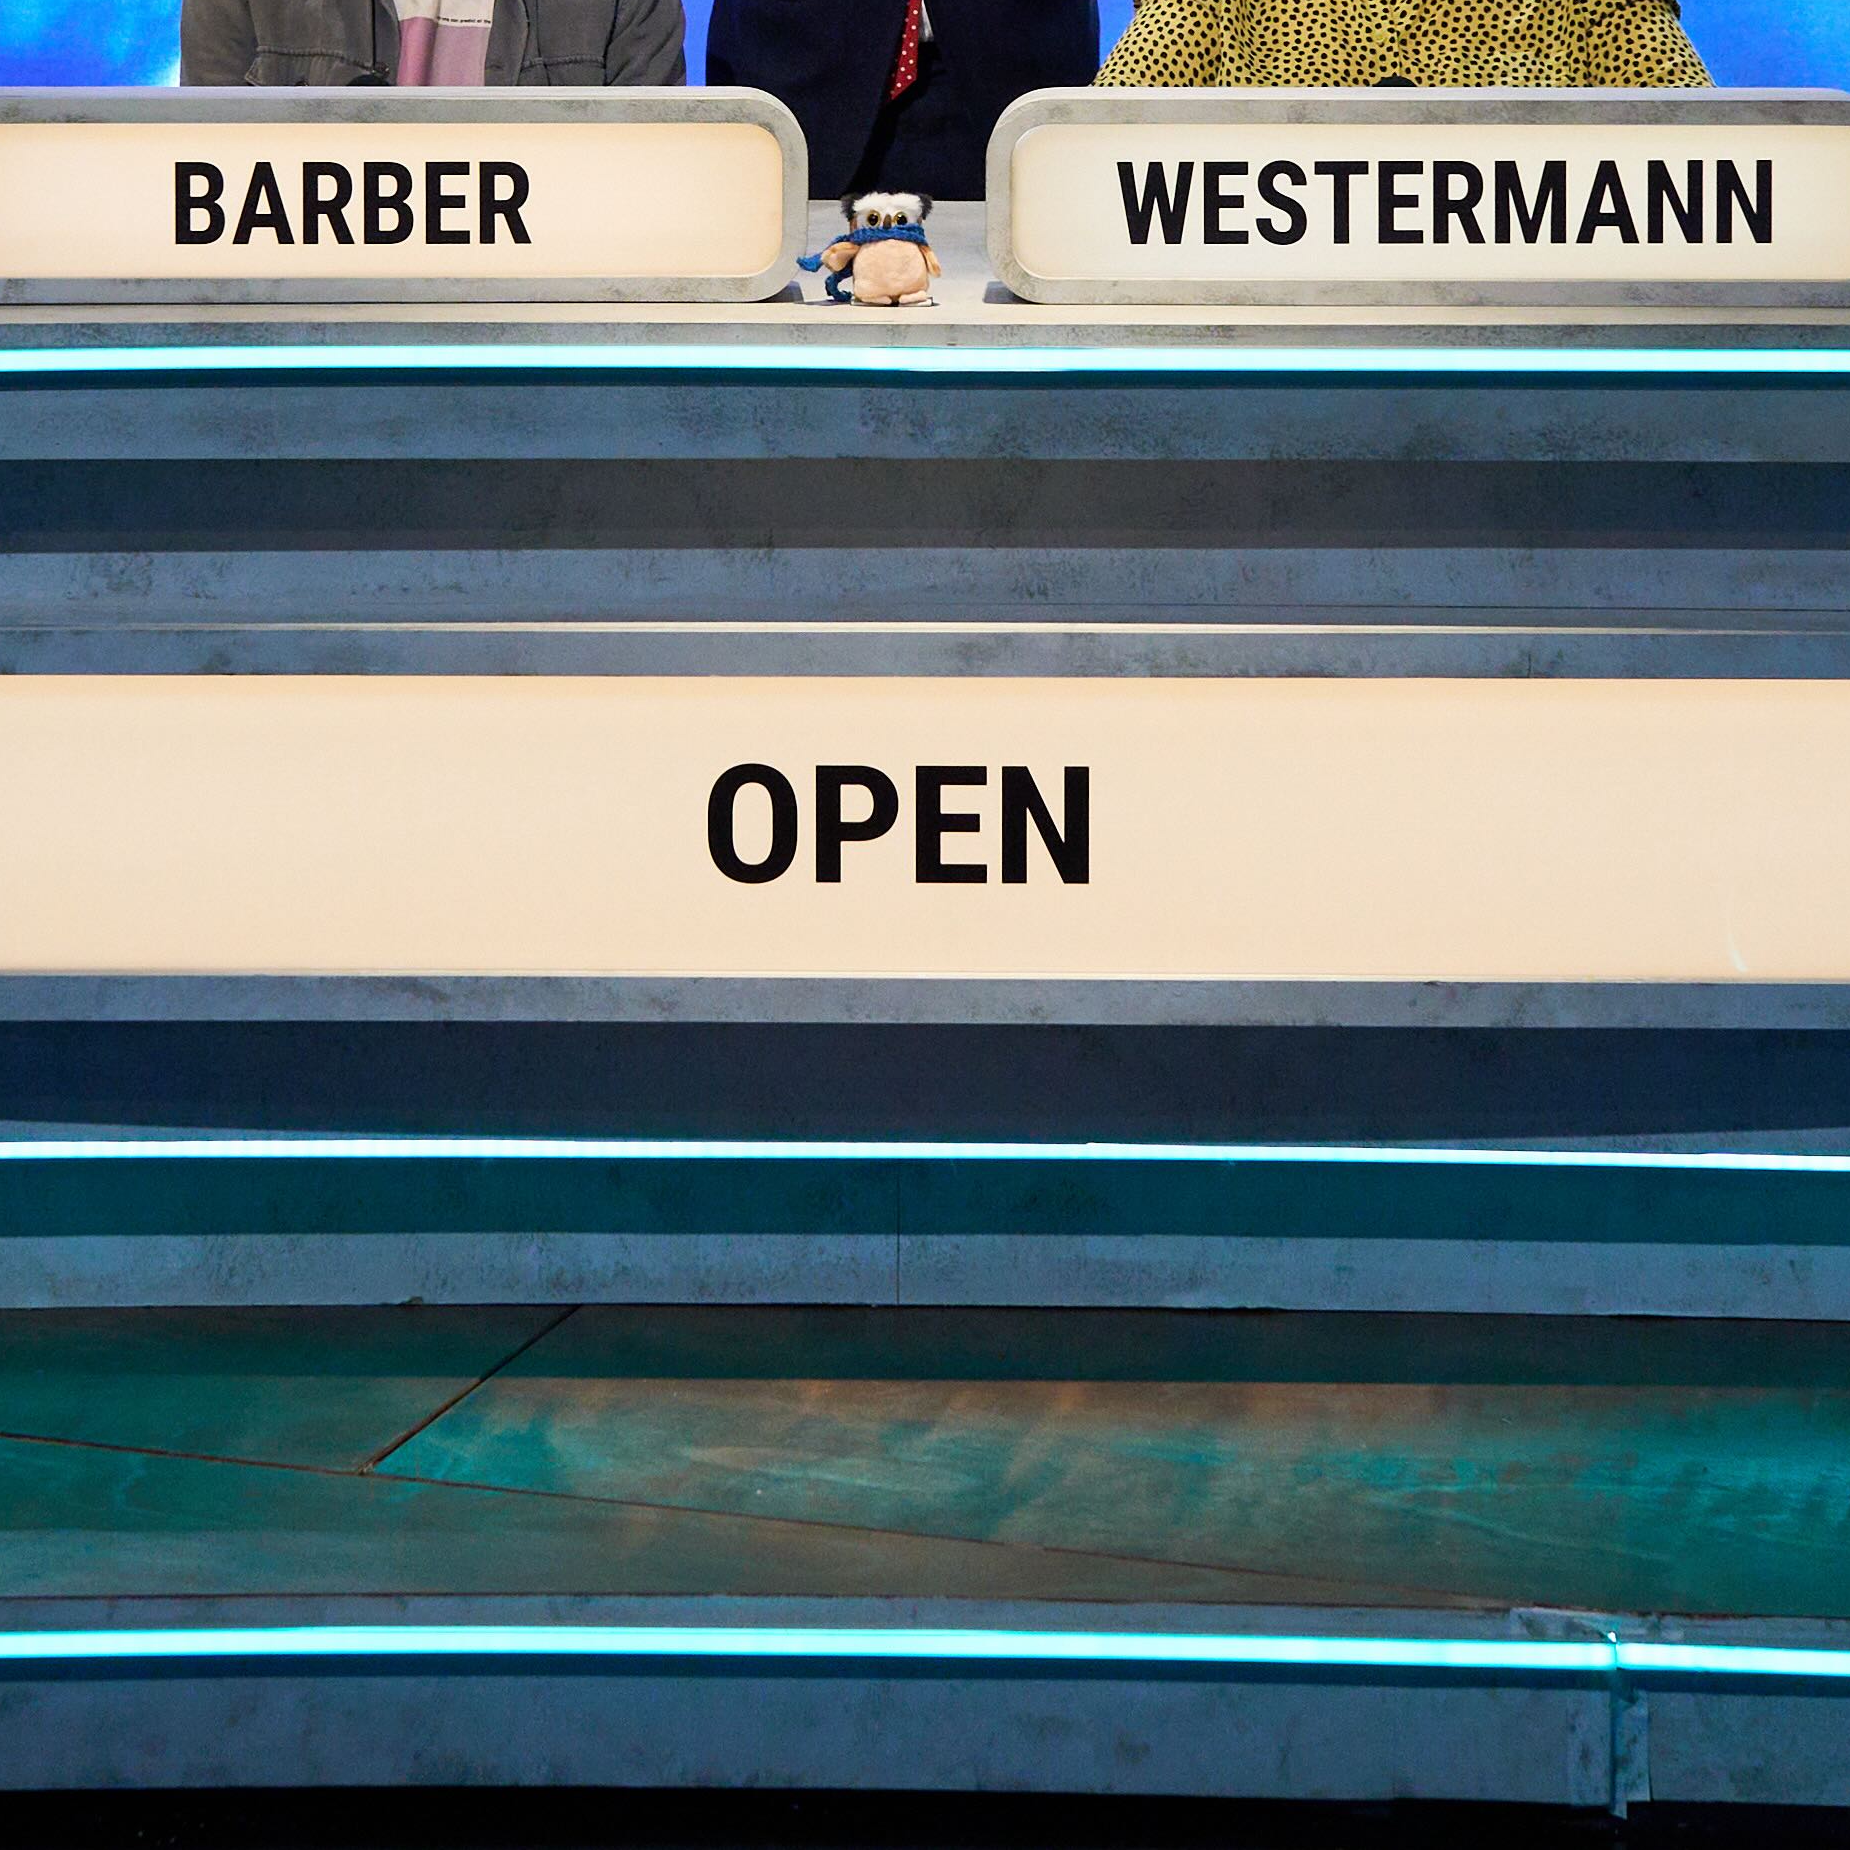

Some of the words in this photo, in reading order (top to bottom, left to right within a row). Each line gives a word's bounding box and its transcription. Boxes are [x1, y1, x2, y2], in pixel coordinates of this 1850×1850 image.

[174, 161, 532, 245] BARBER
[1116, 159, 1773, 246] WESTERMANN
[707, 763, 1090, 885] OPEN
